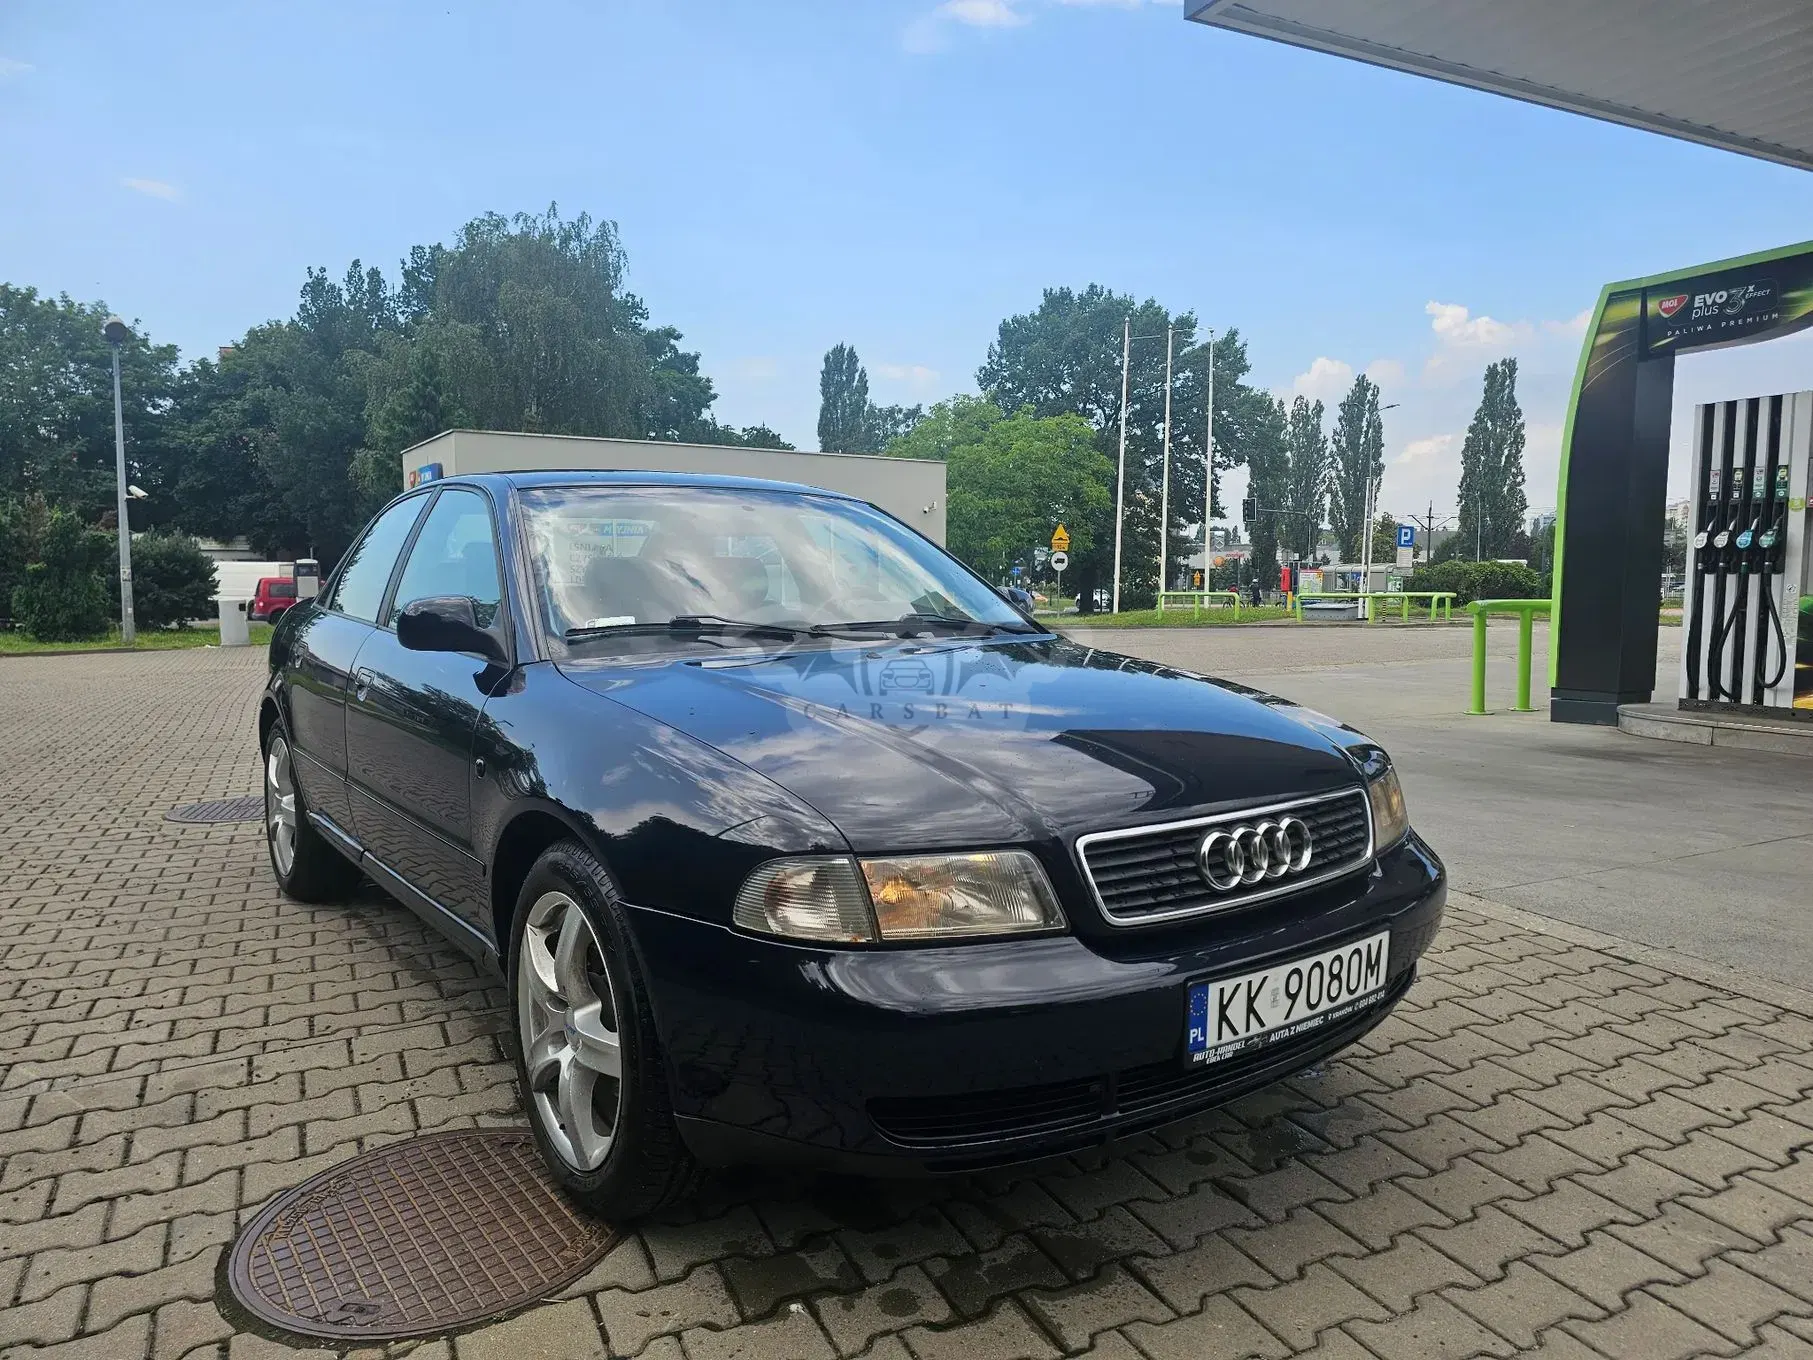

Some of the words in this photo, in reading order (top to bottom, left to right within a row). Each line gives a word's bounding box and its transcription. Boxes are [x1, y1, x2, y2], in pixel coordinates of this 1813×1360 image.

[1661, 298, 1678, 309] MOL
[1693, 290, 1728, 308] EVO
[1723, 286, 1747, 315] 3
[1745, 289, 1770, 299] EFFECT
[1691, 305, 1719, 320] plus
[1667, 324, 1712, 336] PALIWA
[1721, 313, 1779, 328] PREMIUM
[1401, 529, 1411, 545] P
[1217, 975, 1269, 1041] KK
[1284, 939, 1383, 1021] 9080M
[1189, 1027, 1205, 1045] PL
[1270, 1029, 1290, 1043] AUTA
[1295, 1017, 1324, 1034] NIEMIEC
[1193, 1040, 1245, 1062] AUTO-HANDEL
